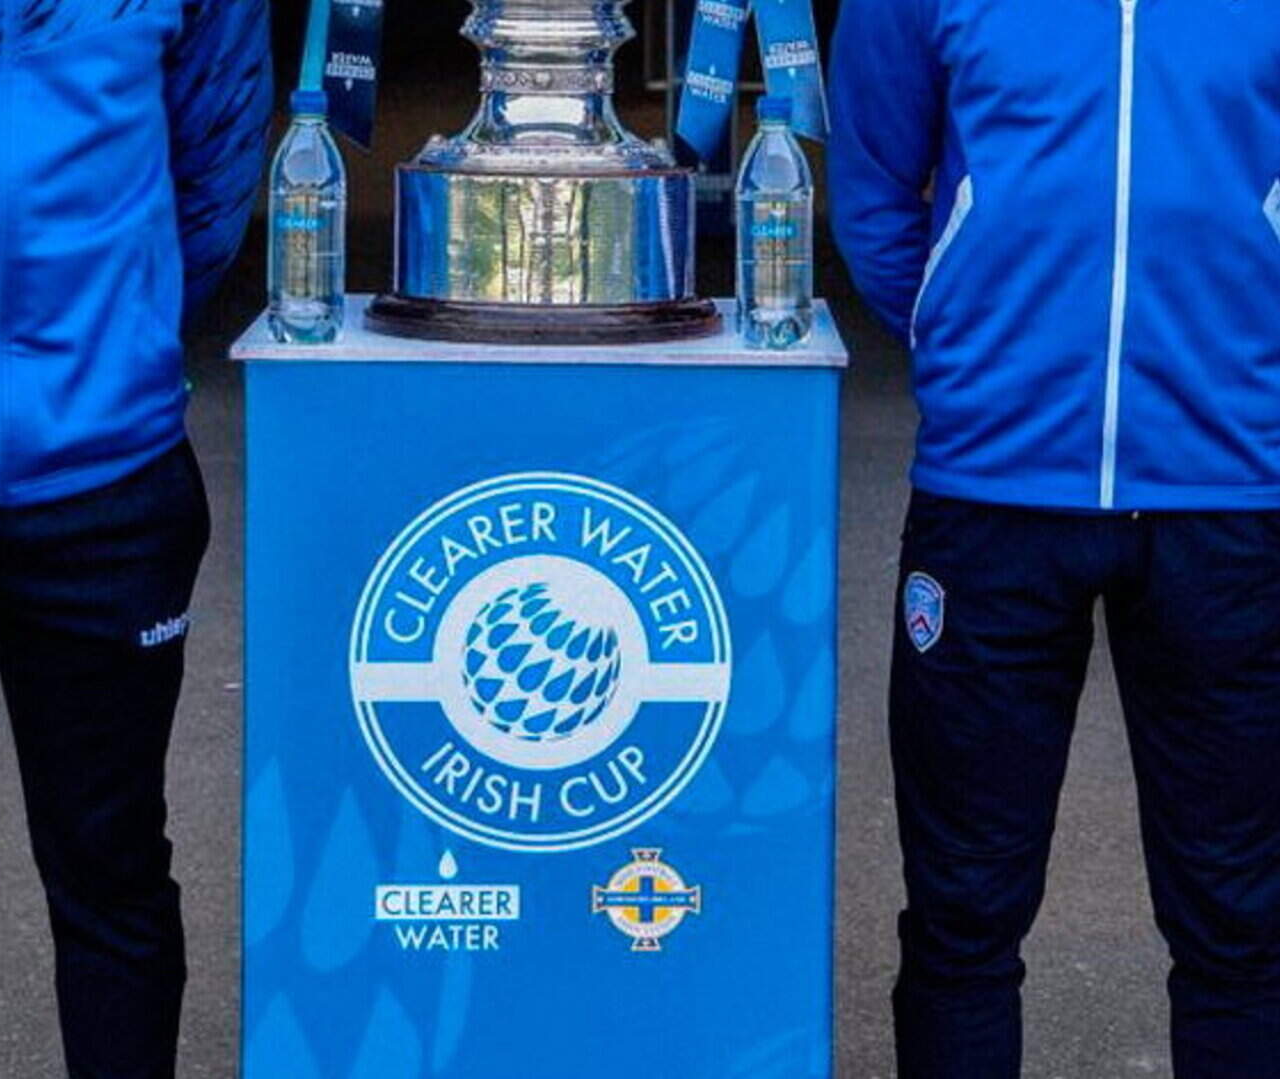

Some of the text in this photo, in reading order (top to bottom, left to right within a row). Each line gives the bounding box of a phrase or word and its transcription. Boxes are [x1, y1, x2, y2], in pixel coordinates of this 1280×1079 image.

[384, 501, 699, 650] CLEARER WATER
[421, 741, 648, 822] IRISH CUP
[381, 890, 512, 916] CLEARER
[395, 925, 500, 950] WATER
